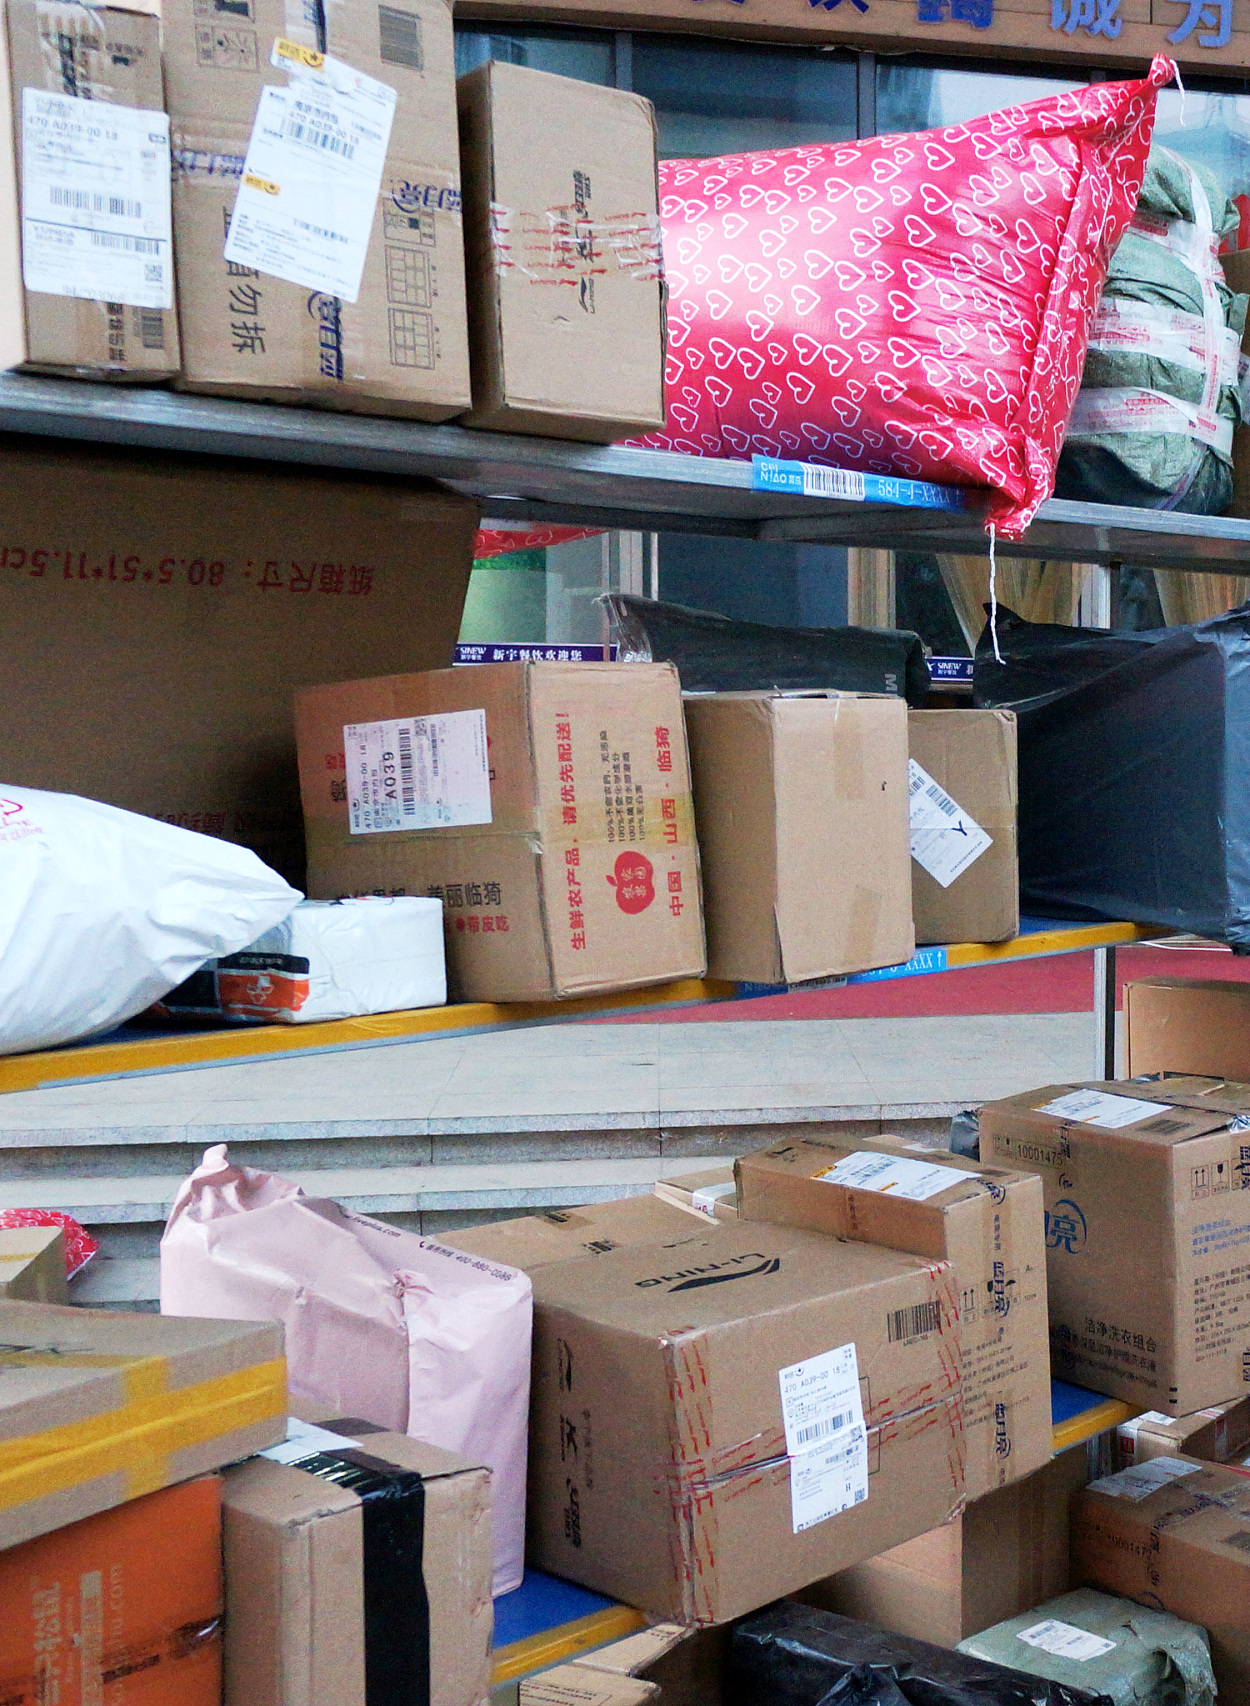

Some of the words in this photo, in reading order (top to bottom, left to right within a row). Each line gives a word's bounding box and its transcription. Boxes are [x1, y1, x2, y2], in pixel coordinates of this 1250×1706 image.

[492, 648, 583, 662] 新宇餐饮欢迎您
[382, 751, 397, 800] A039
[952, 820, 967, 836] Y
[1017, 1145, 1063, 1166] 10001475
[635, 1252, 766, 1288] LI-NING
[784, 1383, 797, 1394] 470
